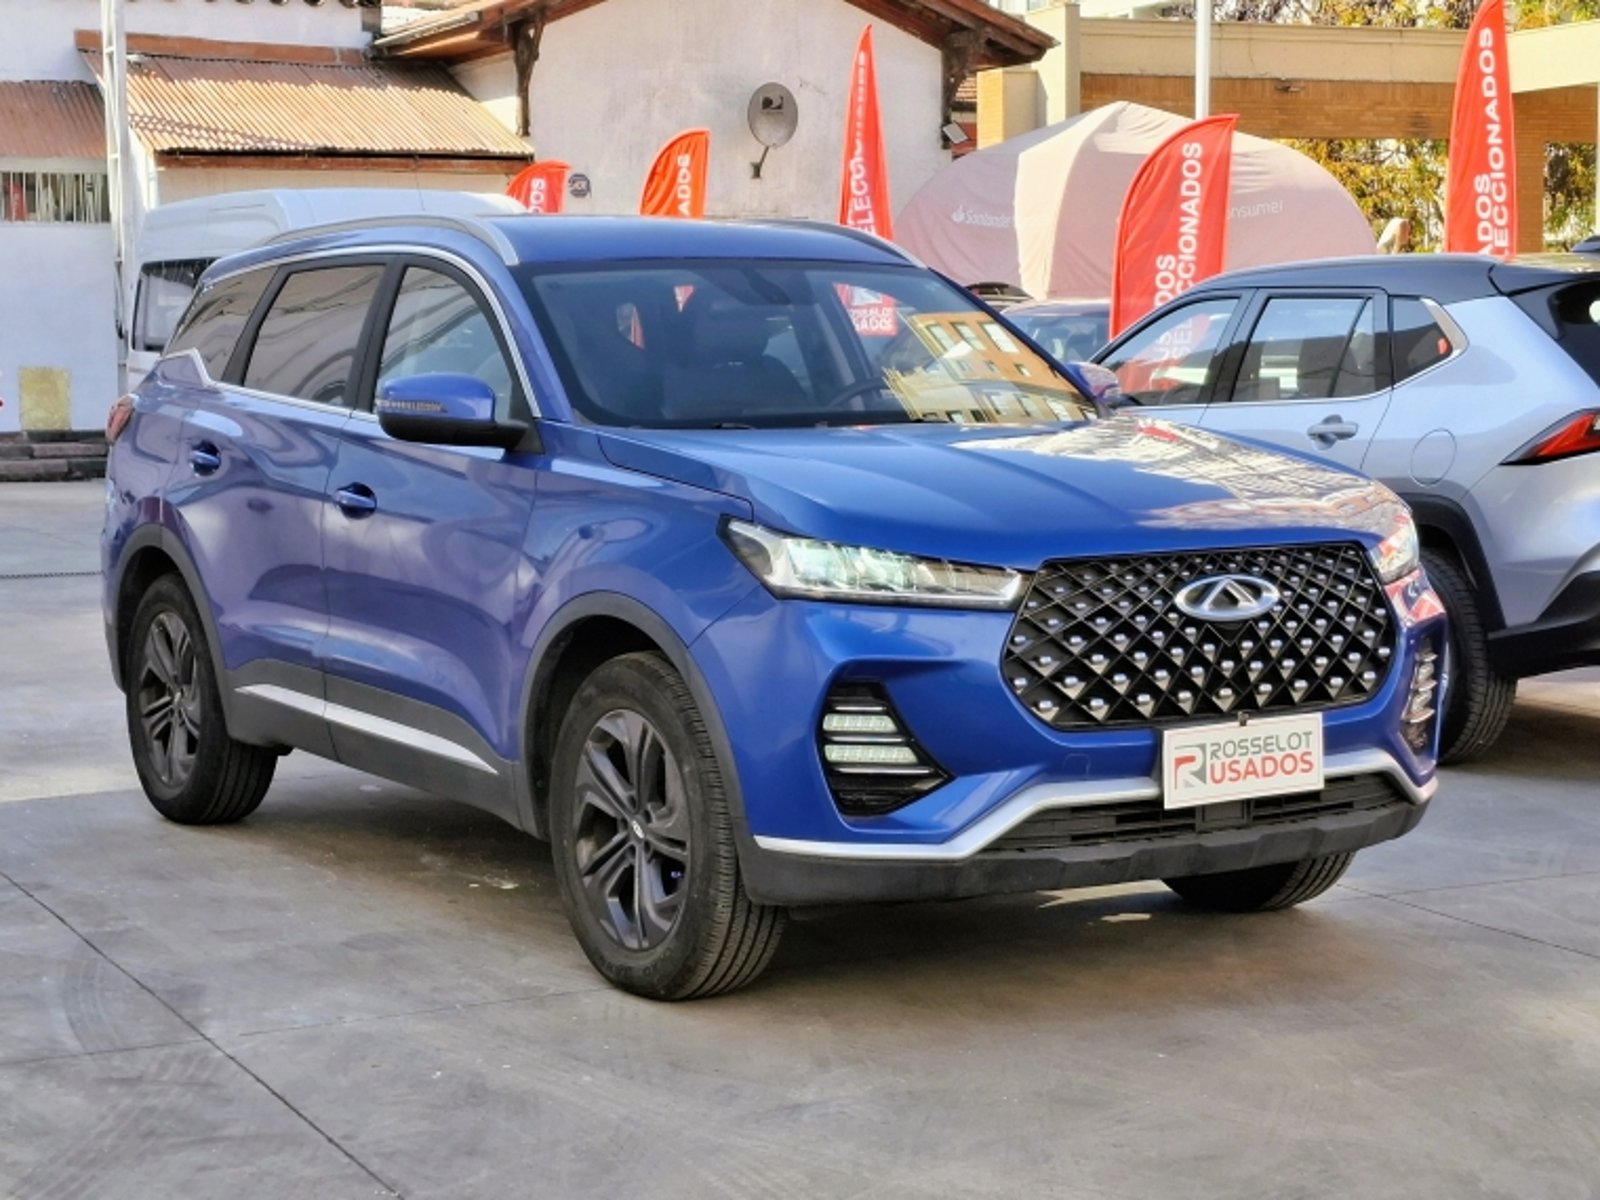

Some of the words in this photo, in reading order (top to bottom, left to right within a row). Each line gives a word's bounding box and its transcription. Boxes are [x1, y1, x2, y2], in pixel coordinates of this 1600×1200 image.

[677, 154, 691, 216] ADOS
[1210, 731, 1313, 760] ROSSELOT
[1210, 751, 1314, 784] USADOS
